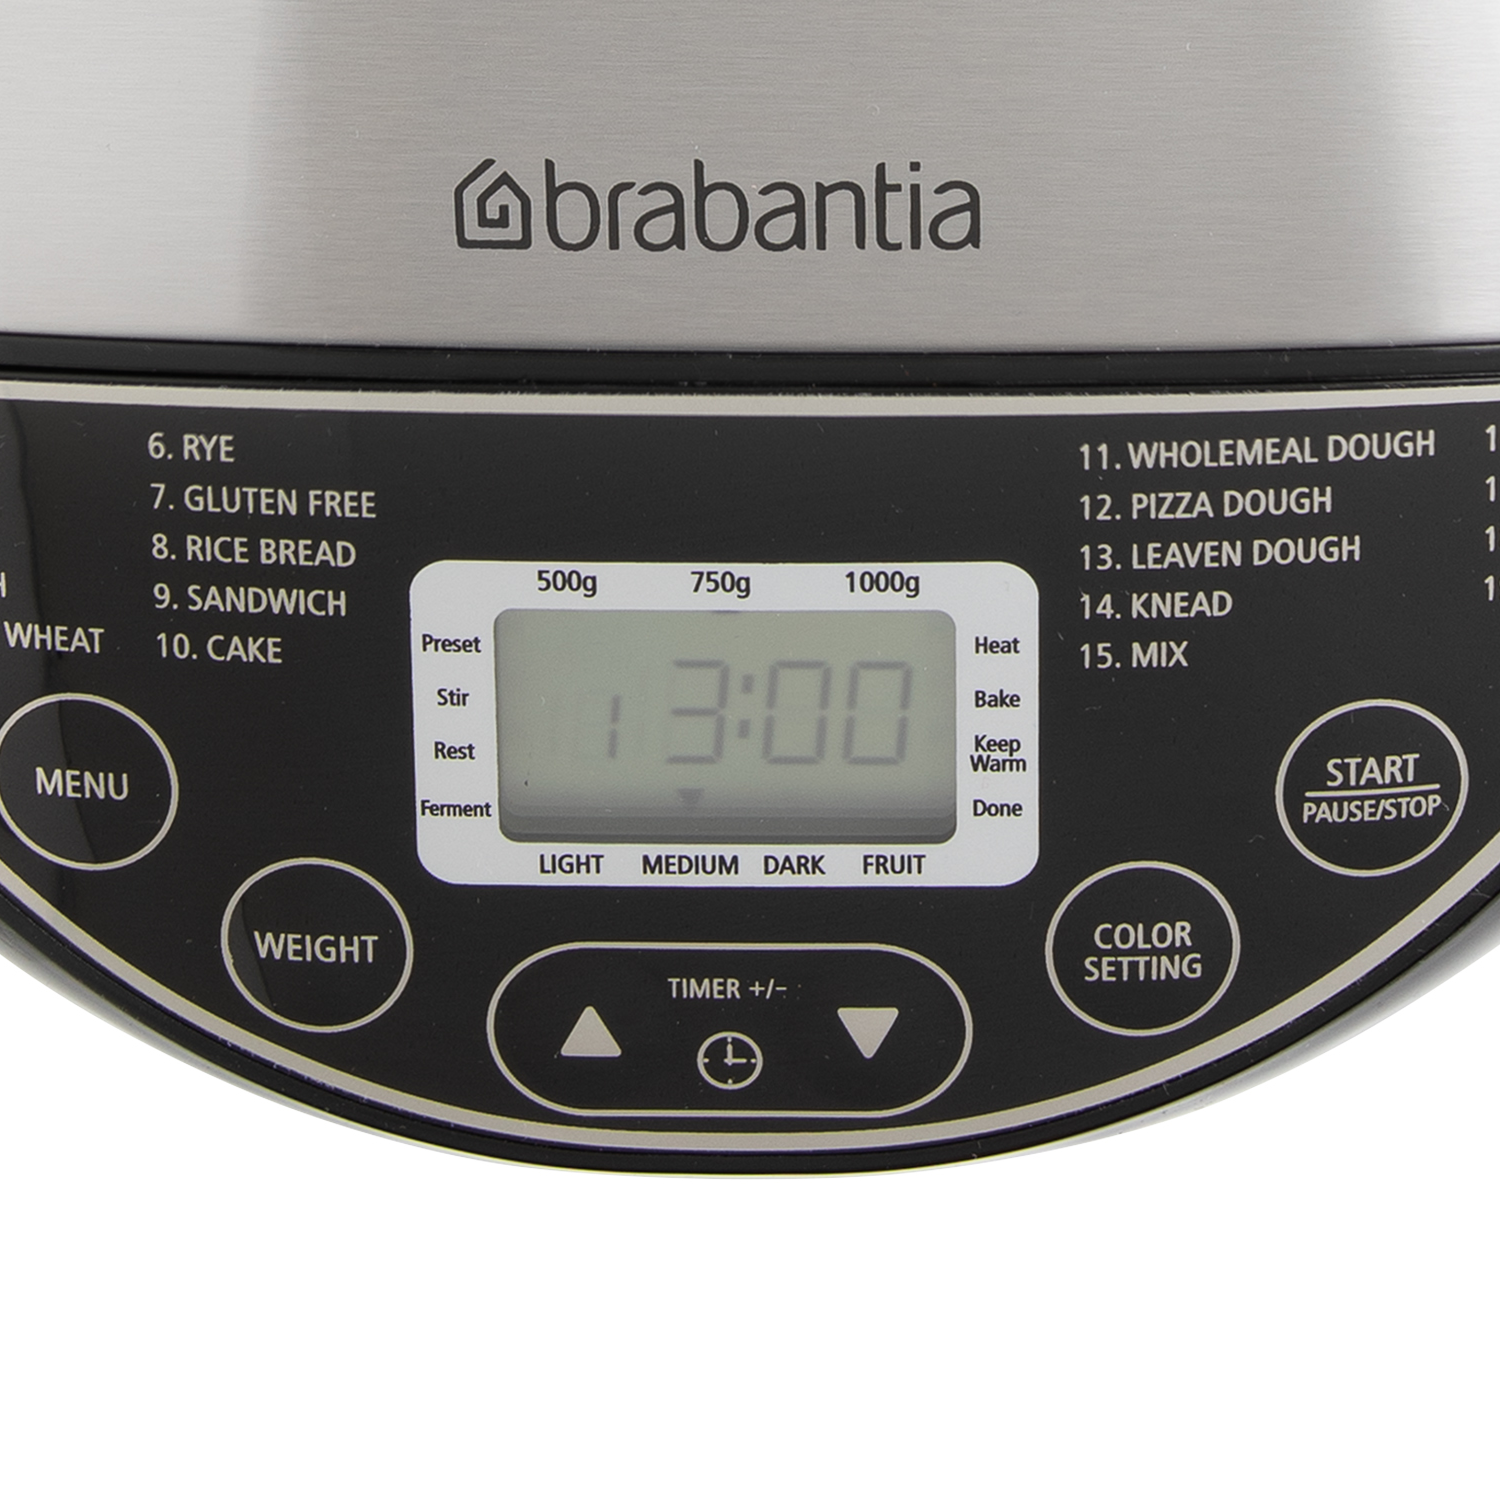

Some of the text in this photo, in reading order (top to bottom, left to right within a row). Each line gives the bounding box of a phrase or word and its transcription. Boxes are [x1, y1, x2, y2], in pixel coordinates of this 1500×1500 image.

[544, 158, 981, 253] brabantia
[148, 432, 235, 463] 6. RYE
[1079, 429, 1435, 471] 11. WHOLEMEAL DOUGH
[150, 483, 377, 518] 7. GLUTEN FREE
[1079, 485, 1332, 521] 12. PIZZA DOUGH
[151, 533, 356, 568] 8. RICE BREAD
[1080, 534, 1361, 571] 13. LEAVEN DOUGH
[537, 569, 920, 599] 500g 750g 1000g
[153, 582, 346, 617] 9. SANDWICH
[1080, 590, 1233, 620] 14. KNEAD
[3, 620, 105, 654] WHEAT
[156, 632, 283, 664] 10. CAKE
[421, 633, 482, 654] Preset
[975, 636, 1020, 655] Heat
[1080, 640, 1189, 669] 15. MIX
[437, 687, 470, 707] Stir
[664, 658, 913, 766] 3:00
[974, 688, 1021, 708] Bake
[434, 741, 476, 760] Rest
[974, 734, 1021, 760] Keep
[969, 752, 1027, 773] Warm
[1326, 753, 1423, 790] START
[35, 766, 129, 801] MENU
[420, 799, 492, 818] Ferment
[972, 799, 1023, 817] Done
[1302, 791, 1442, 824] PAUSE/STOP
[539, 853, 927, 876] LIGHT MEDIUM DARK FRUIT
[253, 930, 379, 963] WEIGHT
[1094, 921, 1192, 950] COLOR
[1084, 952, 1202, 982] SETTING
[667, 977, 741, 999] TIMER
